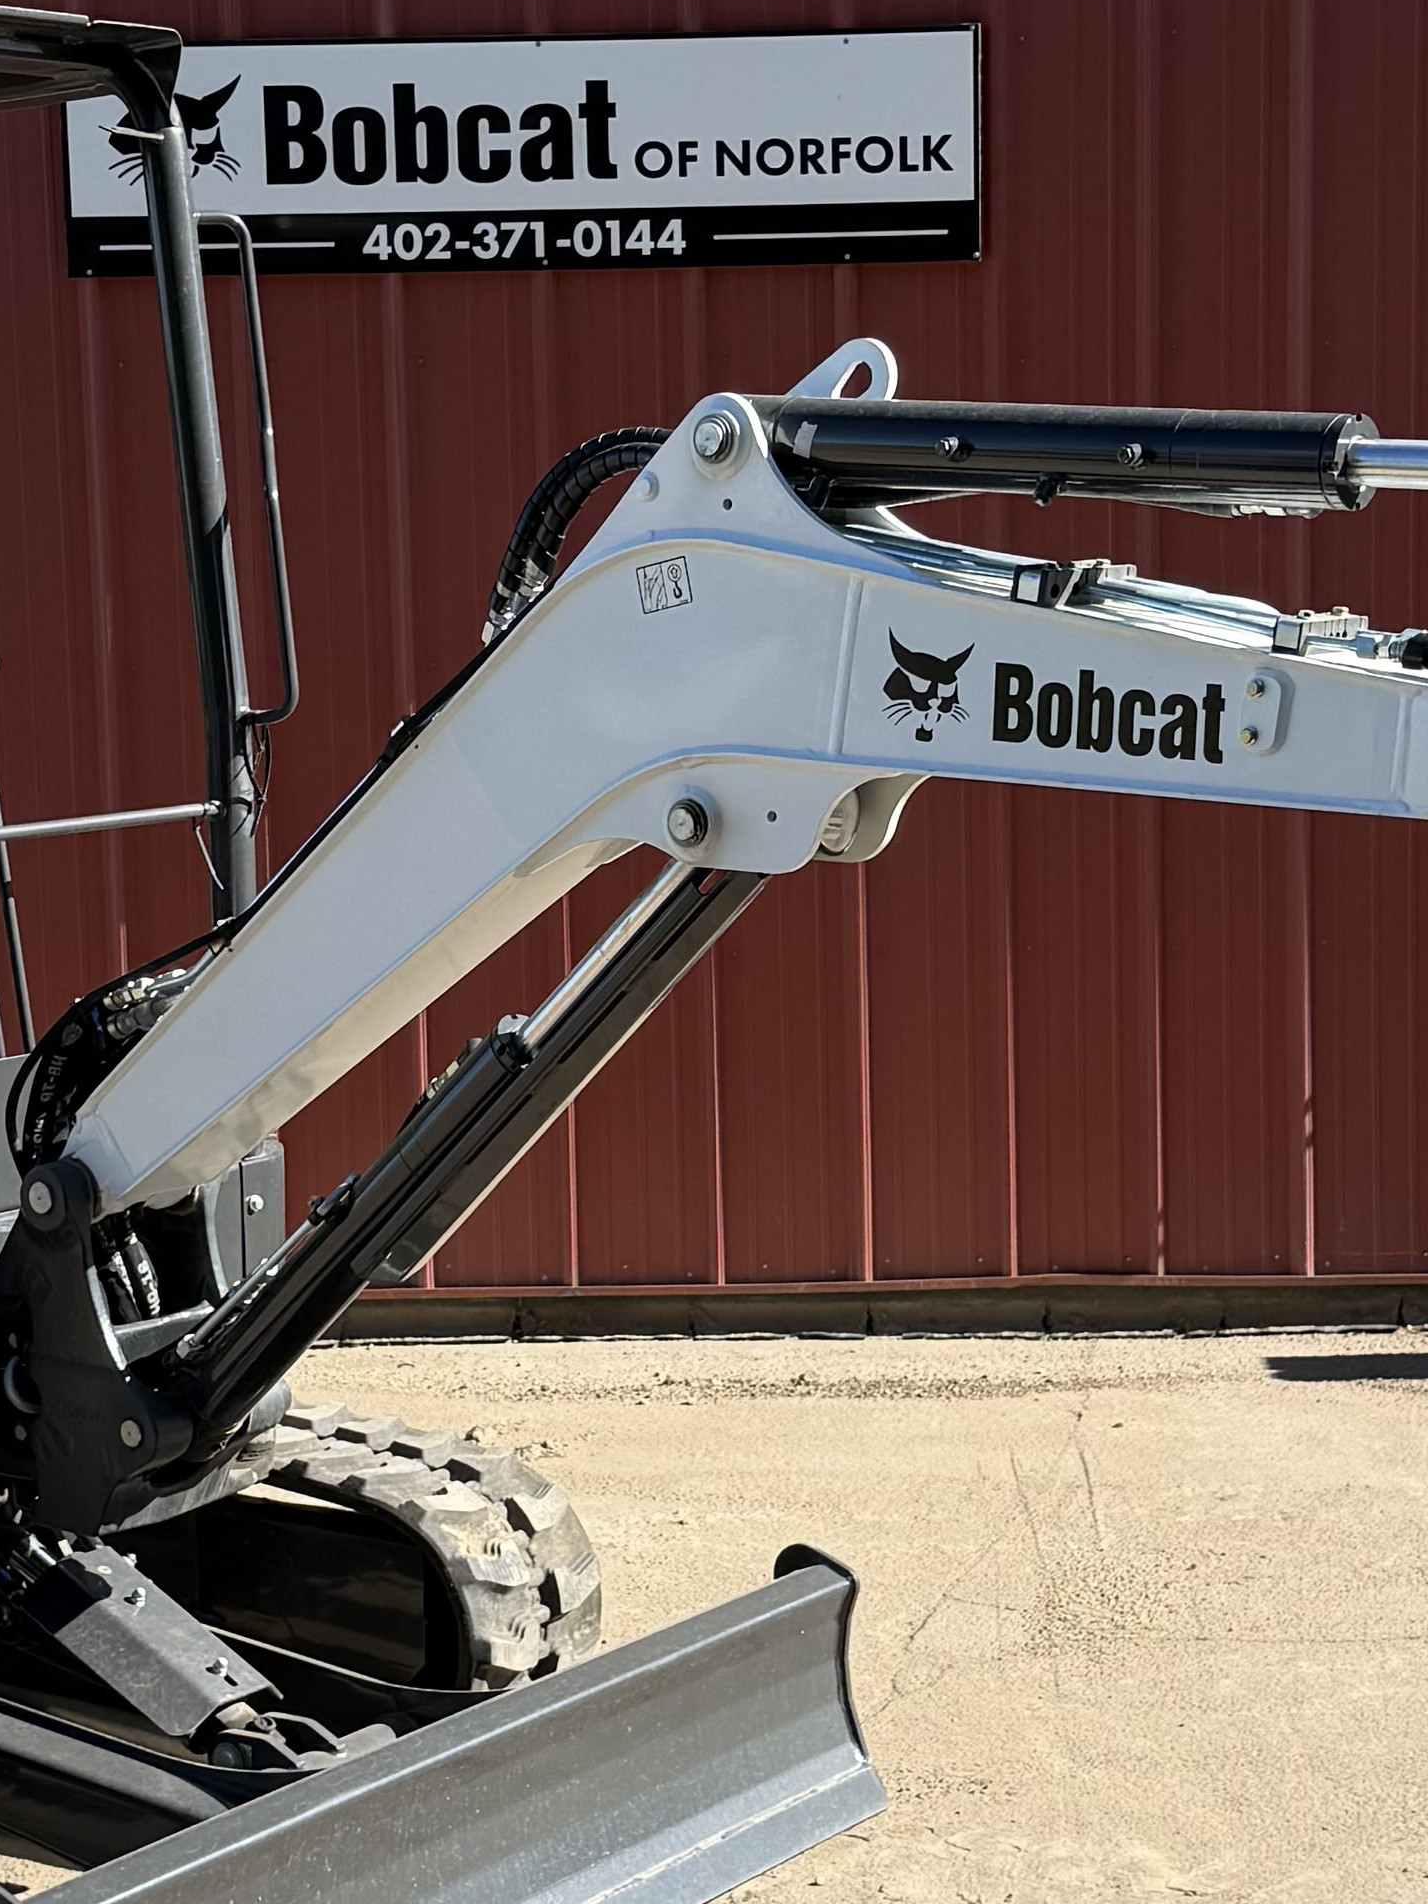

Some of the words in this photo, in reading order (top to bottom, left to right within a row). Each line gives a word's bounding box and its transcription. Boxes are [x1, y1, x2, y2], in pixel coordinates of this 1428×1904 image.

[263, 80, 618, 185] Bobcat
[634, 141, 699, 179] OF
[715, 135, 954, 177] NORFOLK
[362, 219, 687, 261] 402-371-0144
[992, 662, 1225, 764] Bobcat
